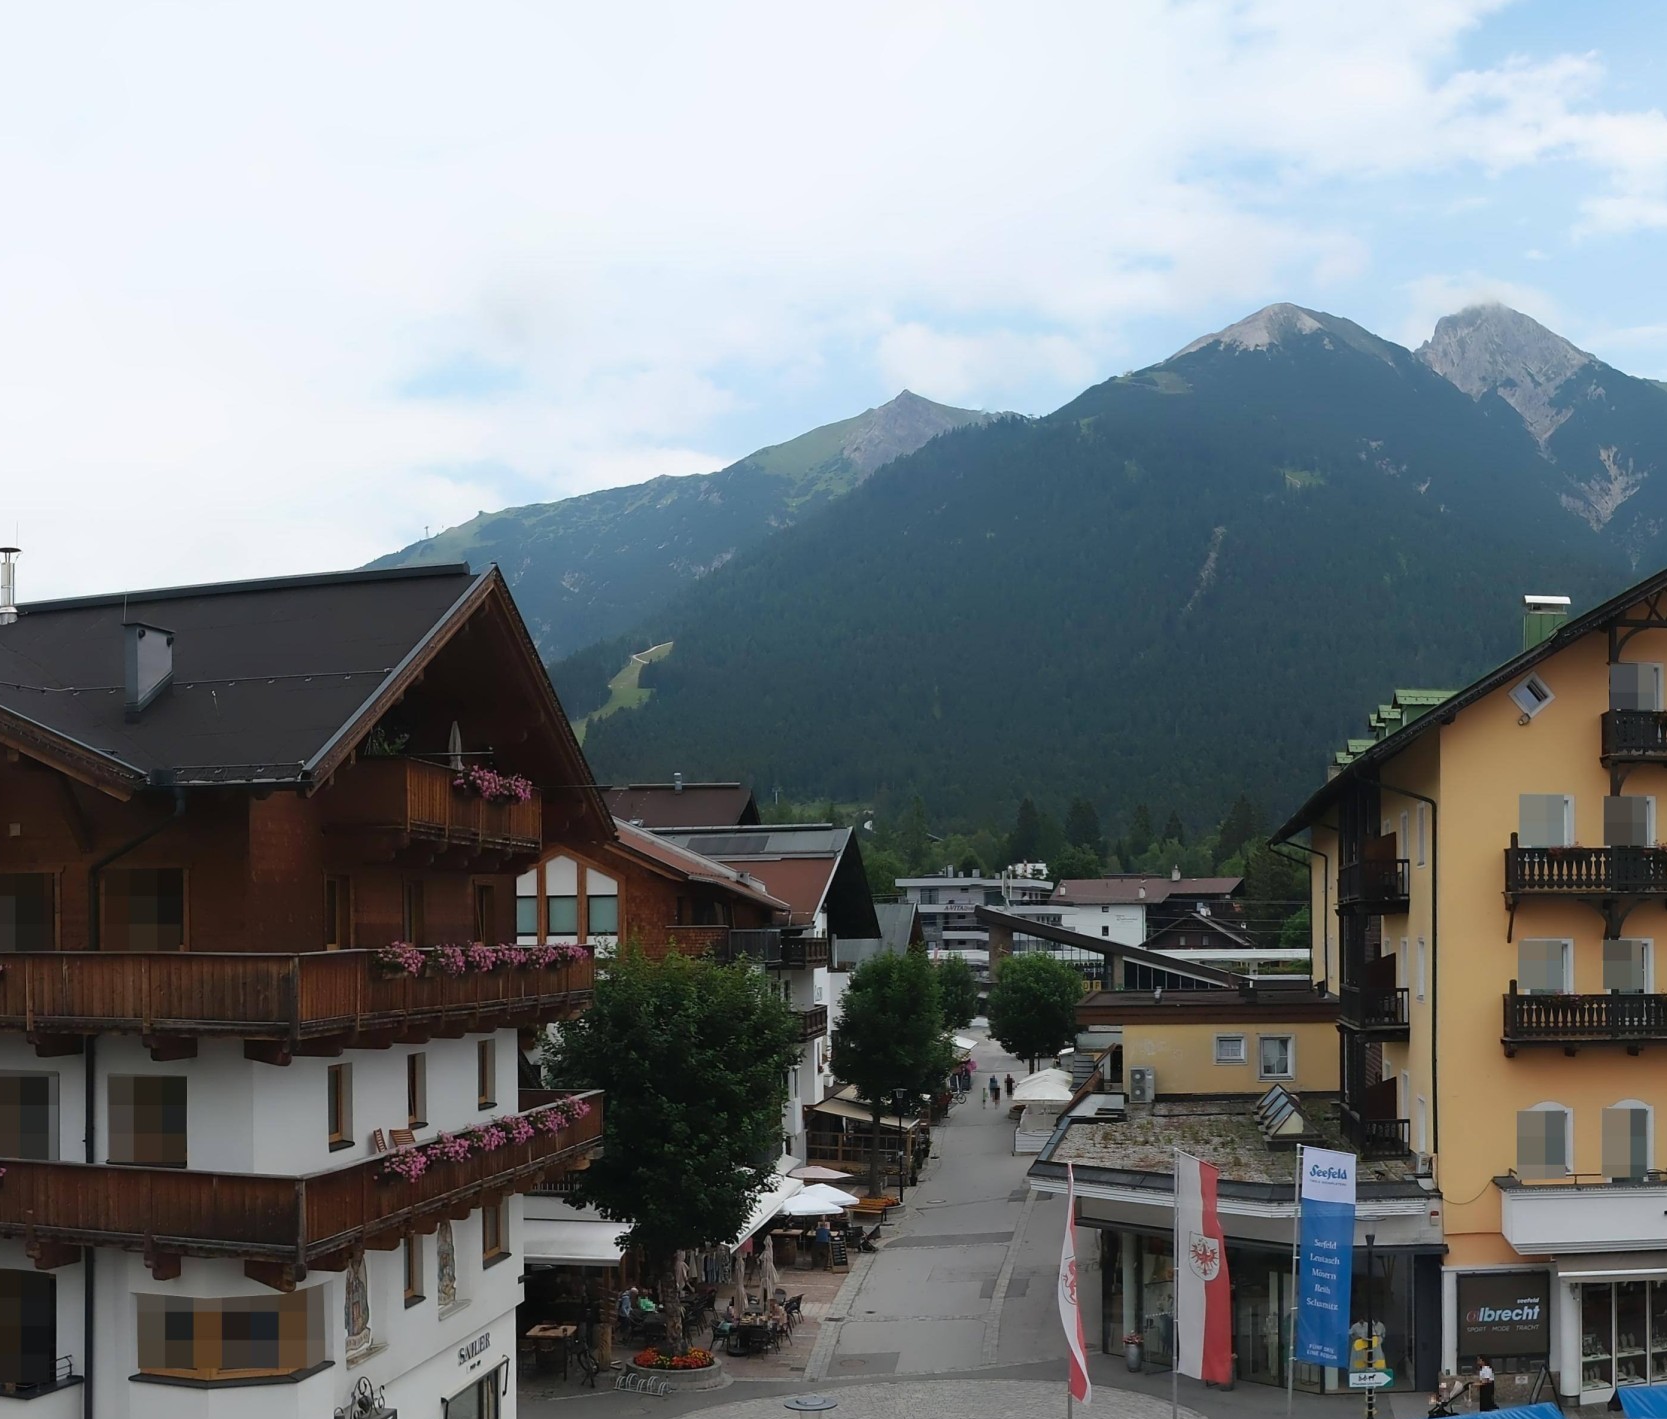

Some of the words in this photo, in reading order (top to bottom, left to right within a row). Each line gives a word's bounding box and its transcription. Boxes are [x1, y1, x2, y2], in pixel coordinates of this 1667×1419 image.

[1309, 1164, 1347, 1180] Seefeld
[1314, 1238, 1337, 1250] Seefeld
[1310, 1253, 1340, 1265] Leutasch
[458, 1332, 491, 1367] SAILER
